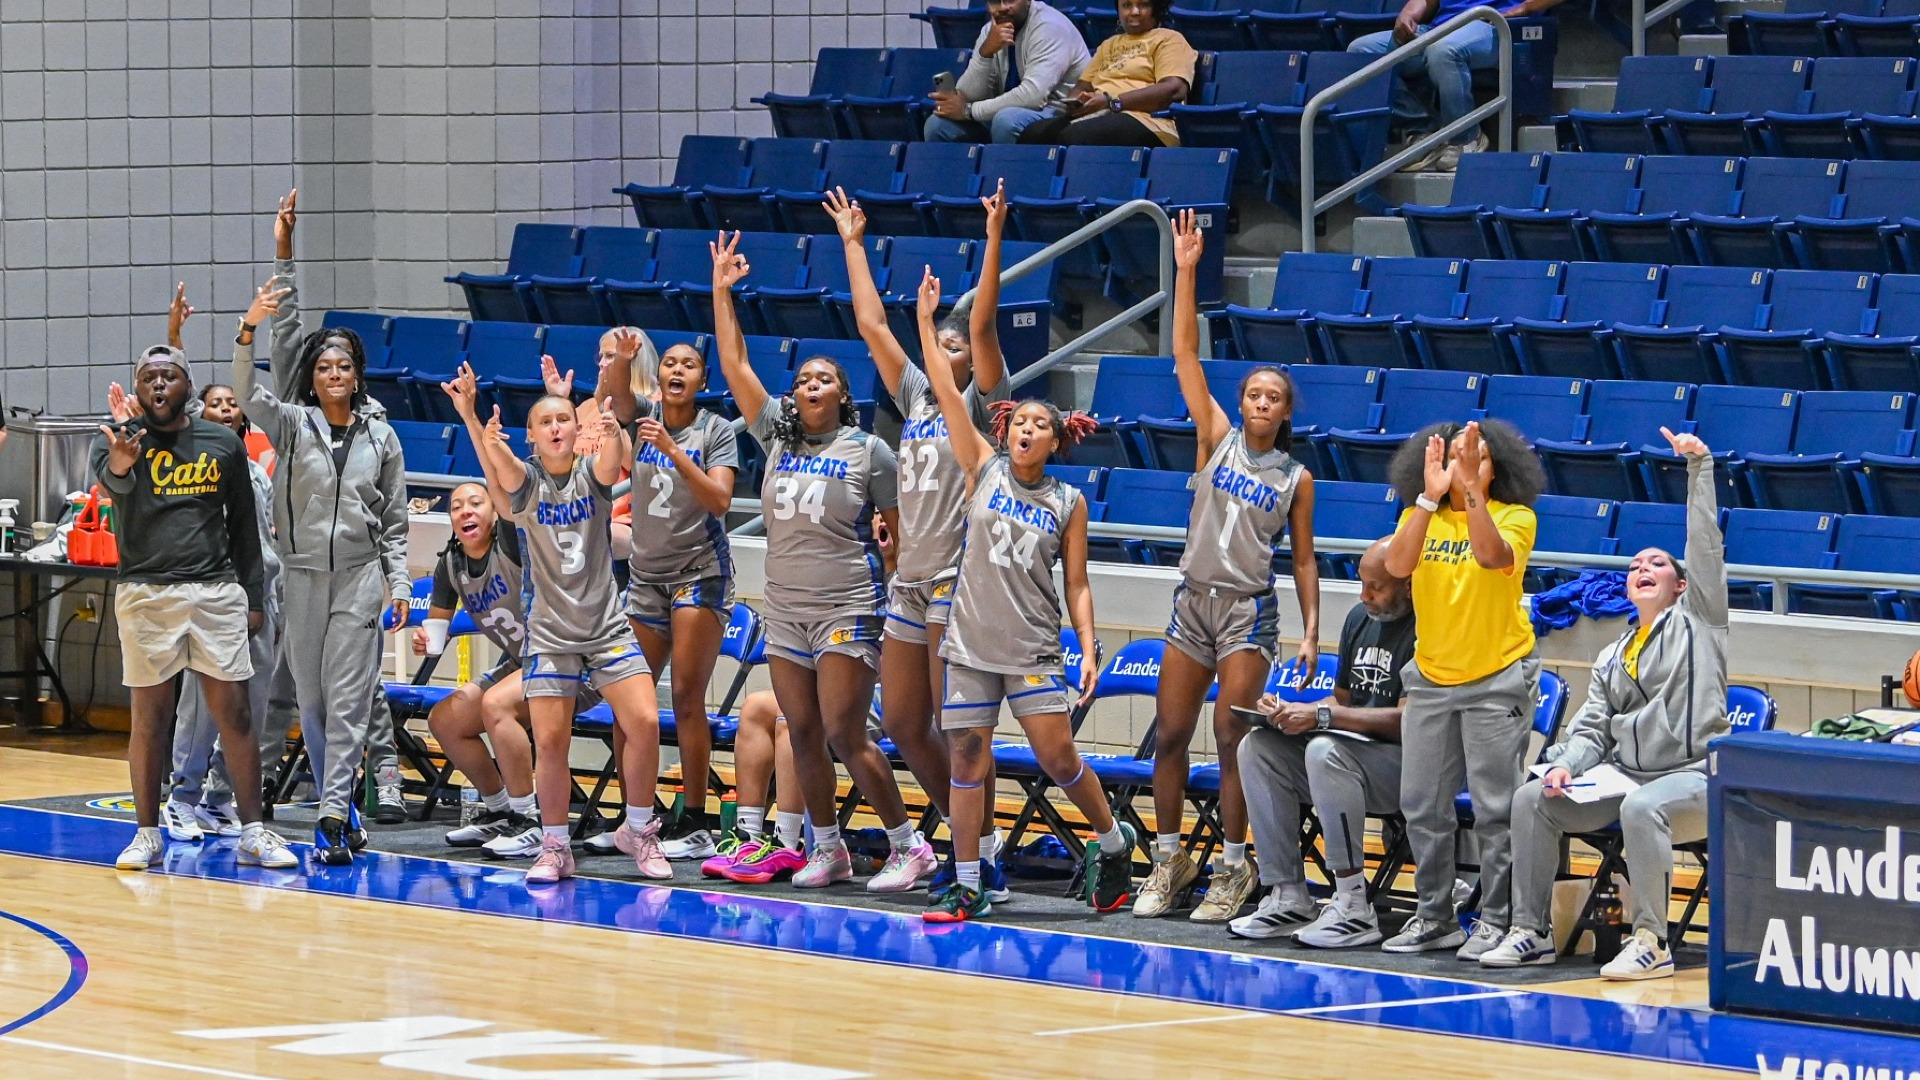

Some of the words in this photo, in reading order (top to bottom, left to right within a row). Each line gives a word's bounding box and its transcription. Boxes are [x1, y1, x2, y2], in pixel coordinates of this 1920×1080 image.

[776, 451, 849, 480] BEARCATS
[901, 444, 940, 493] 32
[537, 494, 596, 526] BEARCATS
[647, 474, 674, 519] 2
[773, 477, 828, 525] 34
[987, 488, 1056, 534] BEARCATS
[1212, 465, 1279, 513] BEARCATS
[988, 519, 1039, 573] 24
[1218, 500, 1241, 550] 1
[558, 530, 586, 575] 3
[1276, 667, 1336, 690] Lader
